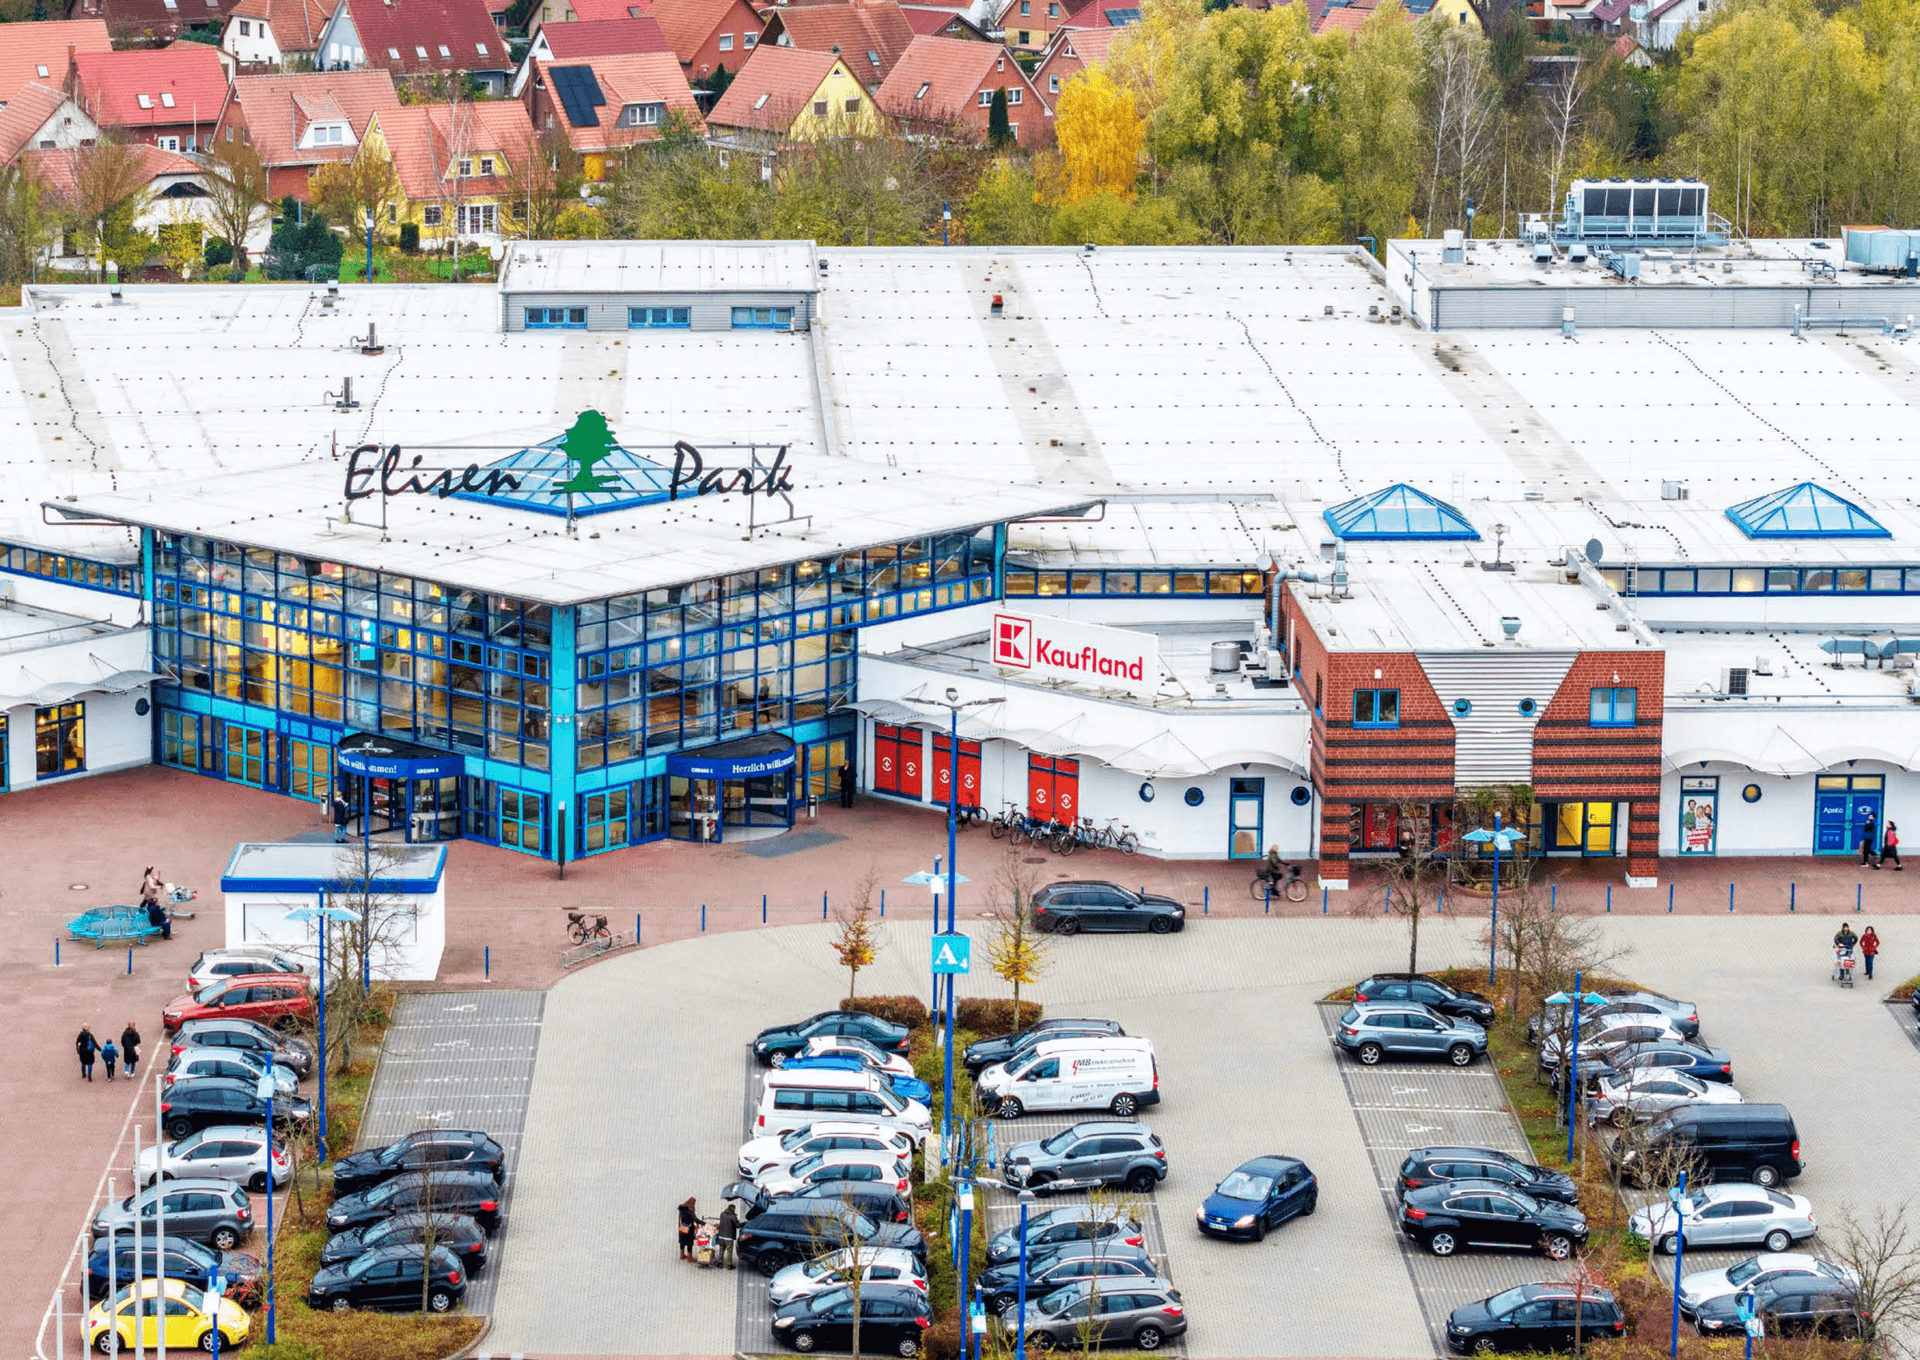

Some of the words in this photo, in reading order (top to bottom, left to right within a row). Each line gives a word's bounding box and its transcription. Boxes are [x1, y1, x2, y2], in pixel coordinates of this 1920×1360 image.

[345, 444, 521, 500] Elisen
[669, 440, 795, 501] Park
[1036, 638, 1143, 682] Kaufland
[732, 762, 766, 774] Herzlich
[934, 942, 958, 965] A
